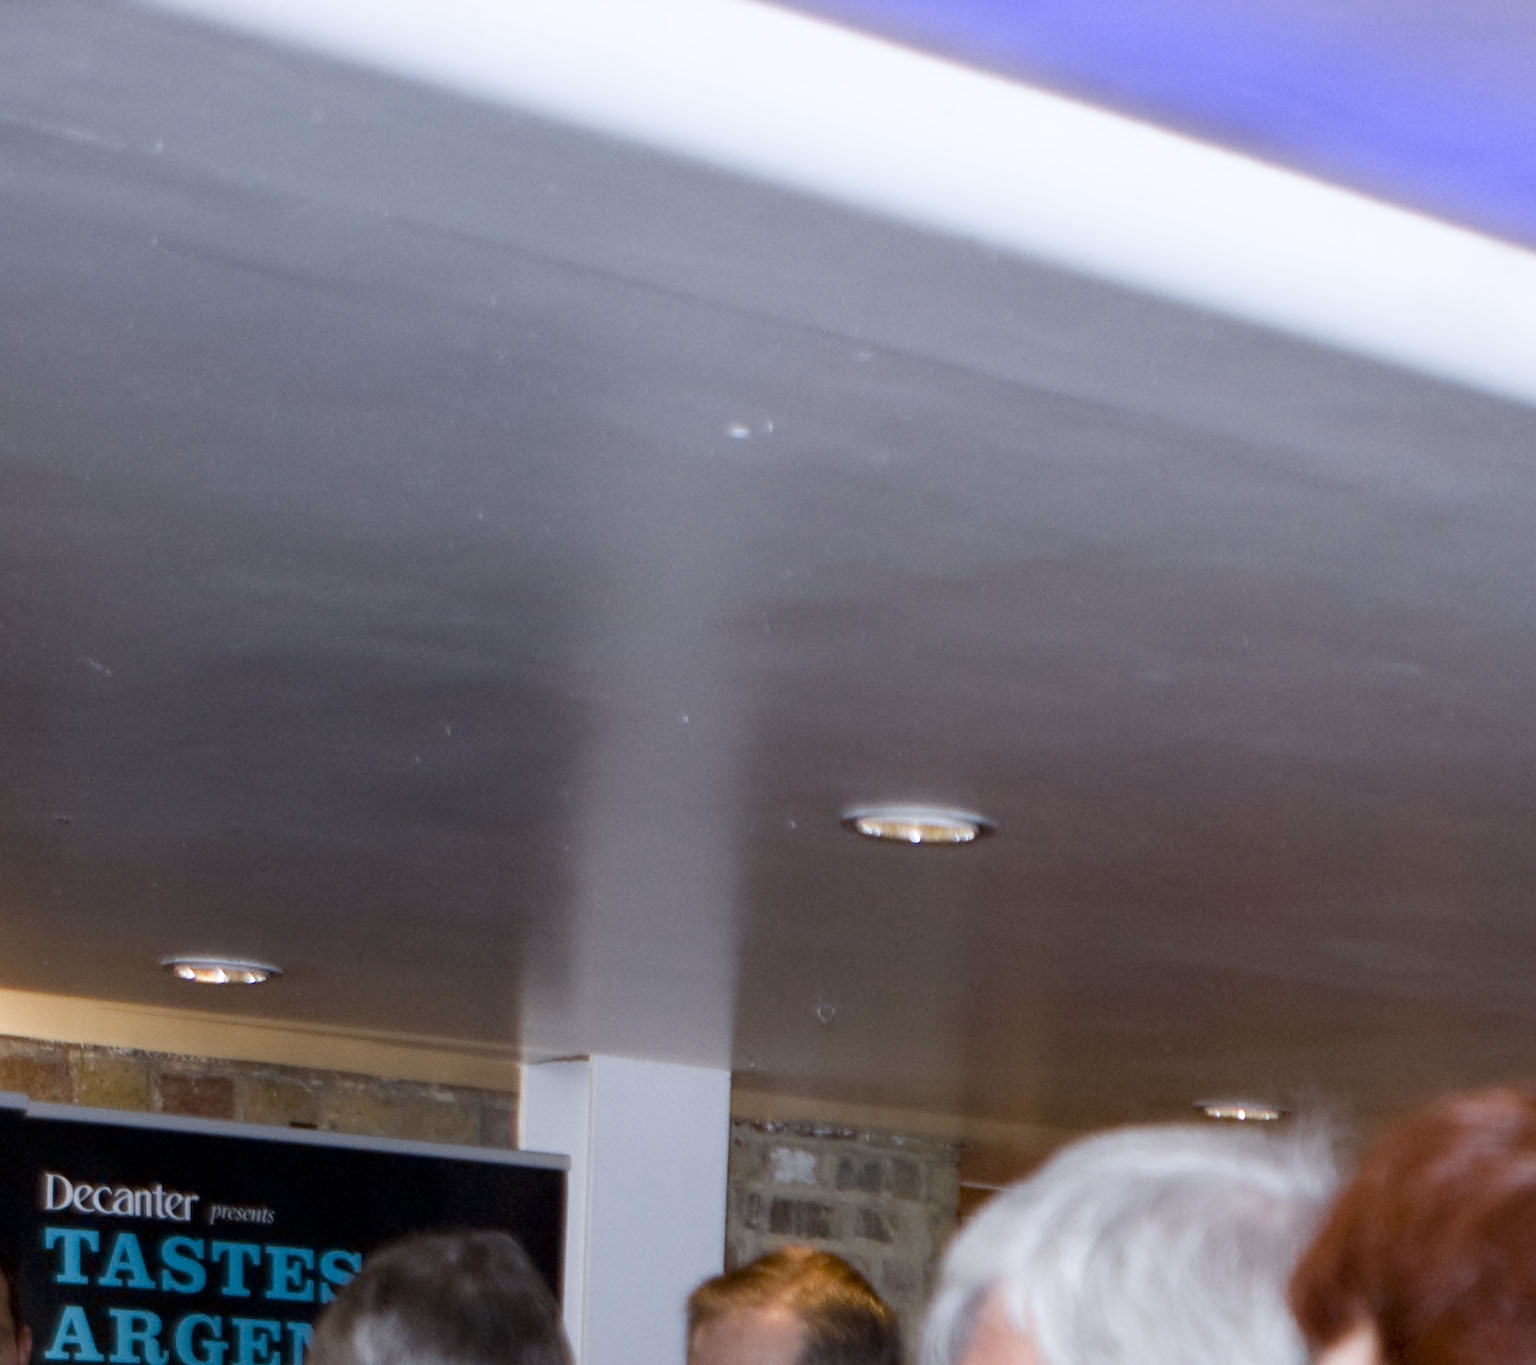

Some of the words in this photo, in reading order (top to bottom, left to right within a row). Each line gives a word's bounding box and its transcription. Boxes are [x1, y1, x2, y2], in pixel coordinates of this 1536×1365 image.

[44, 1172, 200, 1222] Decanter
[208, 1202, 276, 1226] presents
[44, 1226, 363, 1305] TASTES
